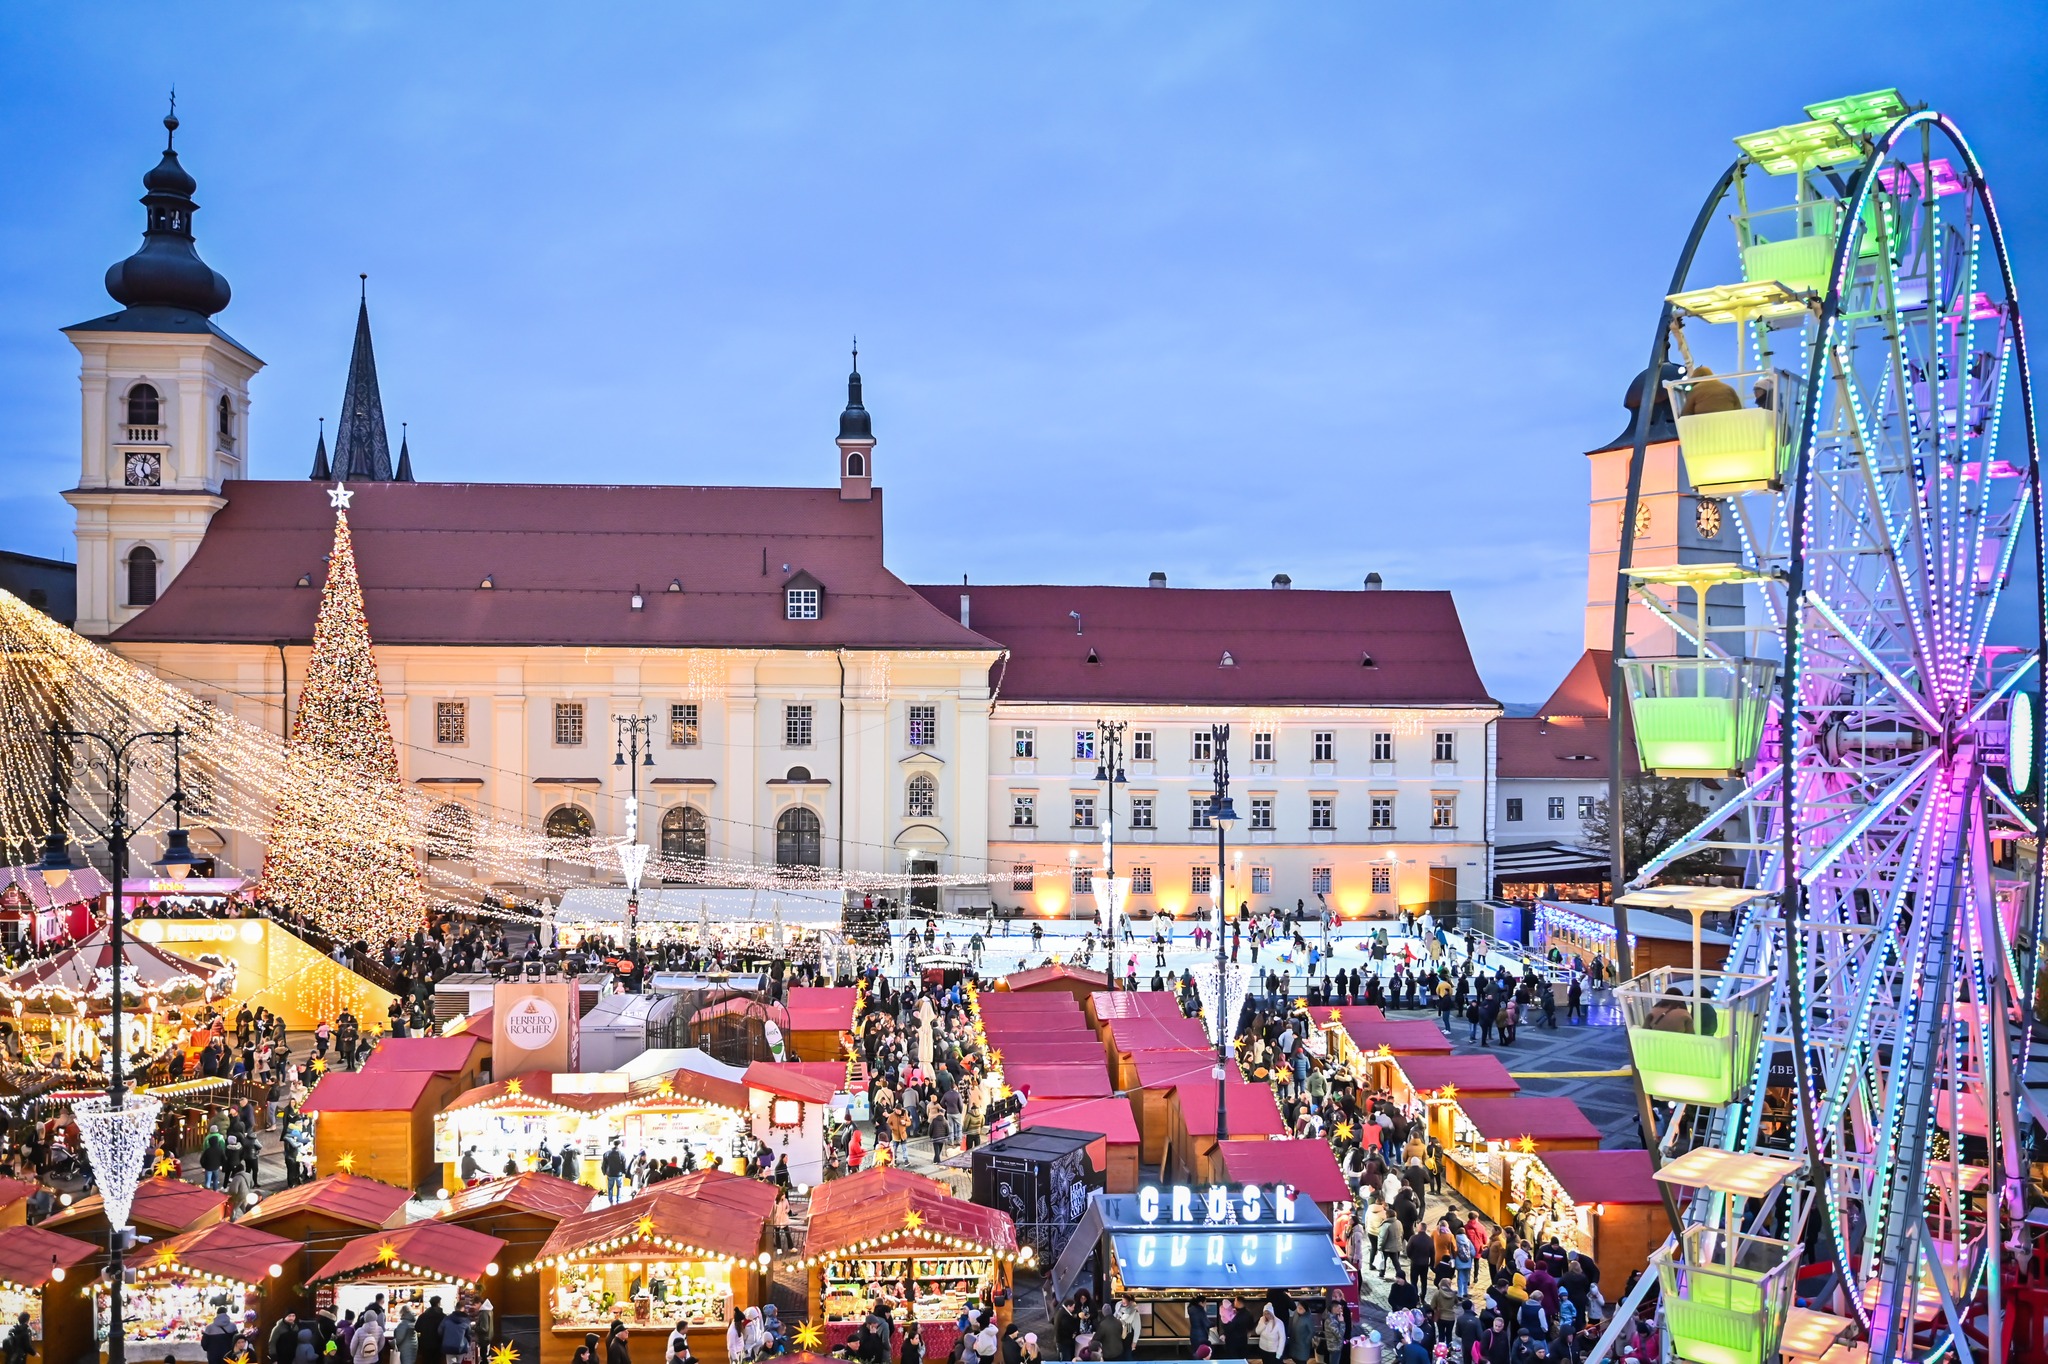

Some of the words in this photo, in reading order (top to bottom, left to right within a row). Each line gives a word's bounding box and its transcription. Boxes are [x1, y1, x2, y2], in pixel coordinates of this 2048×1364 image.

[510, 1015, 552, 1025] FERRERO
[510, 1025, 552, 1034] ROCHER
[1139, 1184, 1295, 1222] CRUSH
